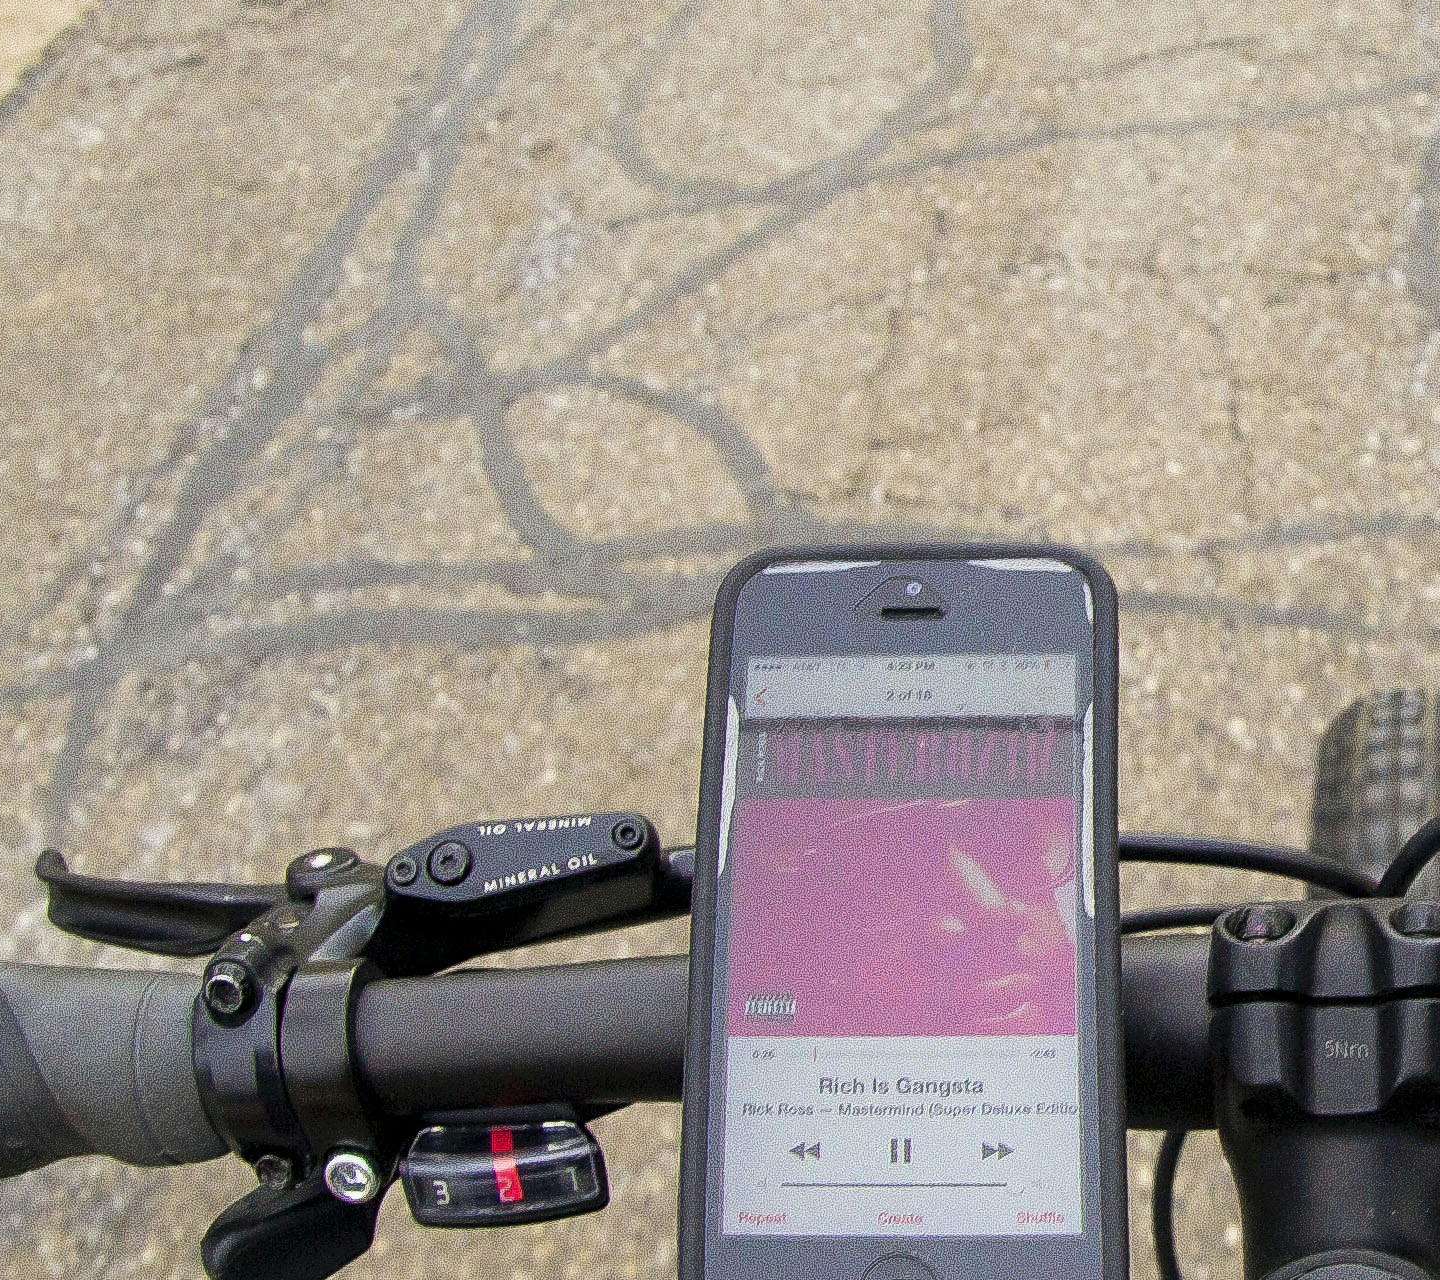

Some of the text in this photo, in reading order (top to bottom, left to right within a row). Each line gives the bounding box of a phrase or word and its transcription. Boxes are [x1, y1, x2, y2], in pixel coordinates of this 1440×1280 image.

[885, 690, 896, 702] 2
[897, 689, 914, 702] of
[477, 816, 593, 837] MINERAL OIL
[483, 852, 598, 894] MINERAL OIL
[818, 1077, 985, 1100] Rich Is Gangsta
[742, 1102, 772, 1116] Rick
[777, 1102, 815, 1116] Ross
[838, 1102, 925, 1116] Mastermind
[928, 1102, 977, 1119] (Super
[981, 1102, 1032, 1116] Deluxe
[432, 1166, 579, 1205] 3 2 1
[737, 1210, 787, 1226] Repeat
[876, 1210, 924, 1224] Create
[1016, 1210, 1066, 1224] Shuffle
